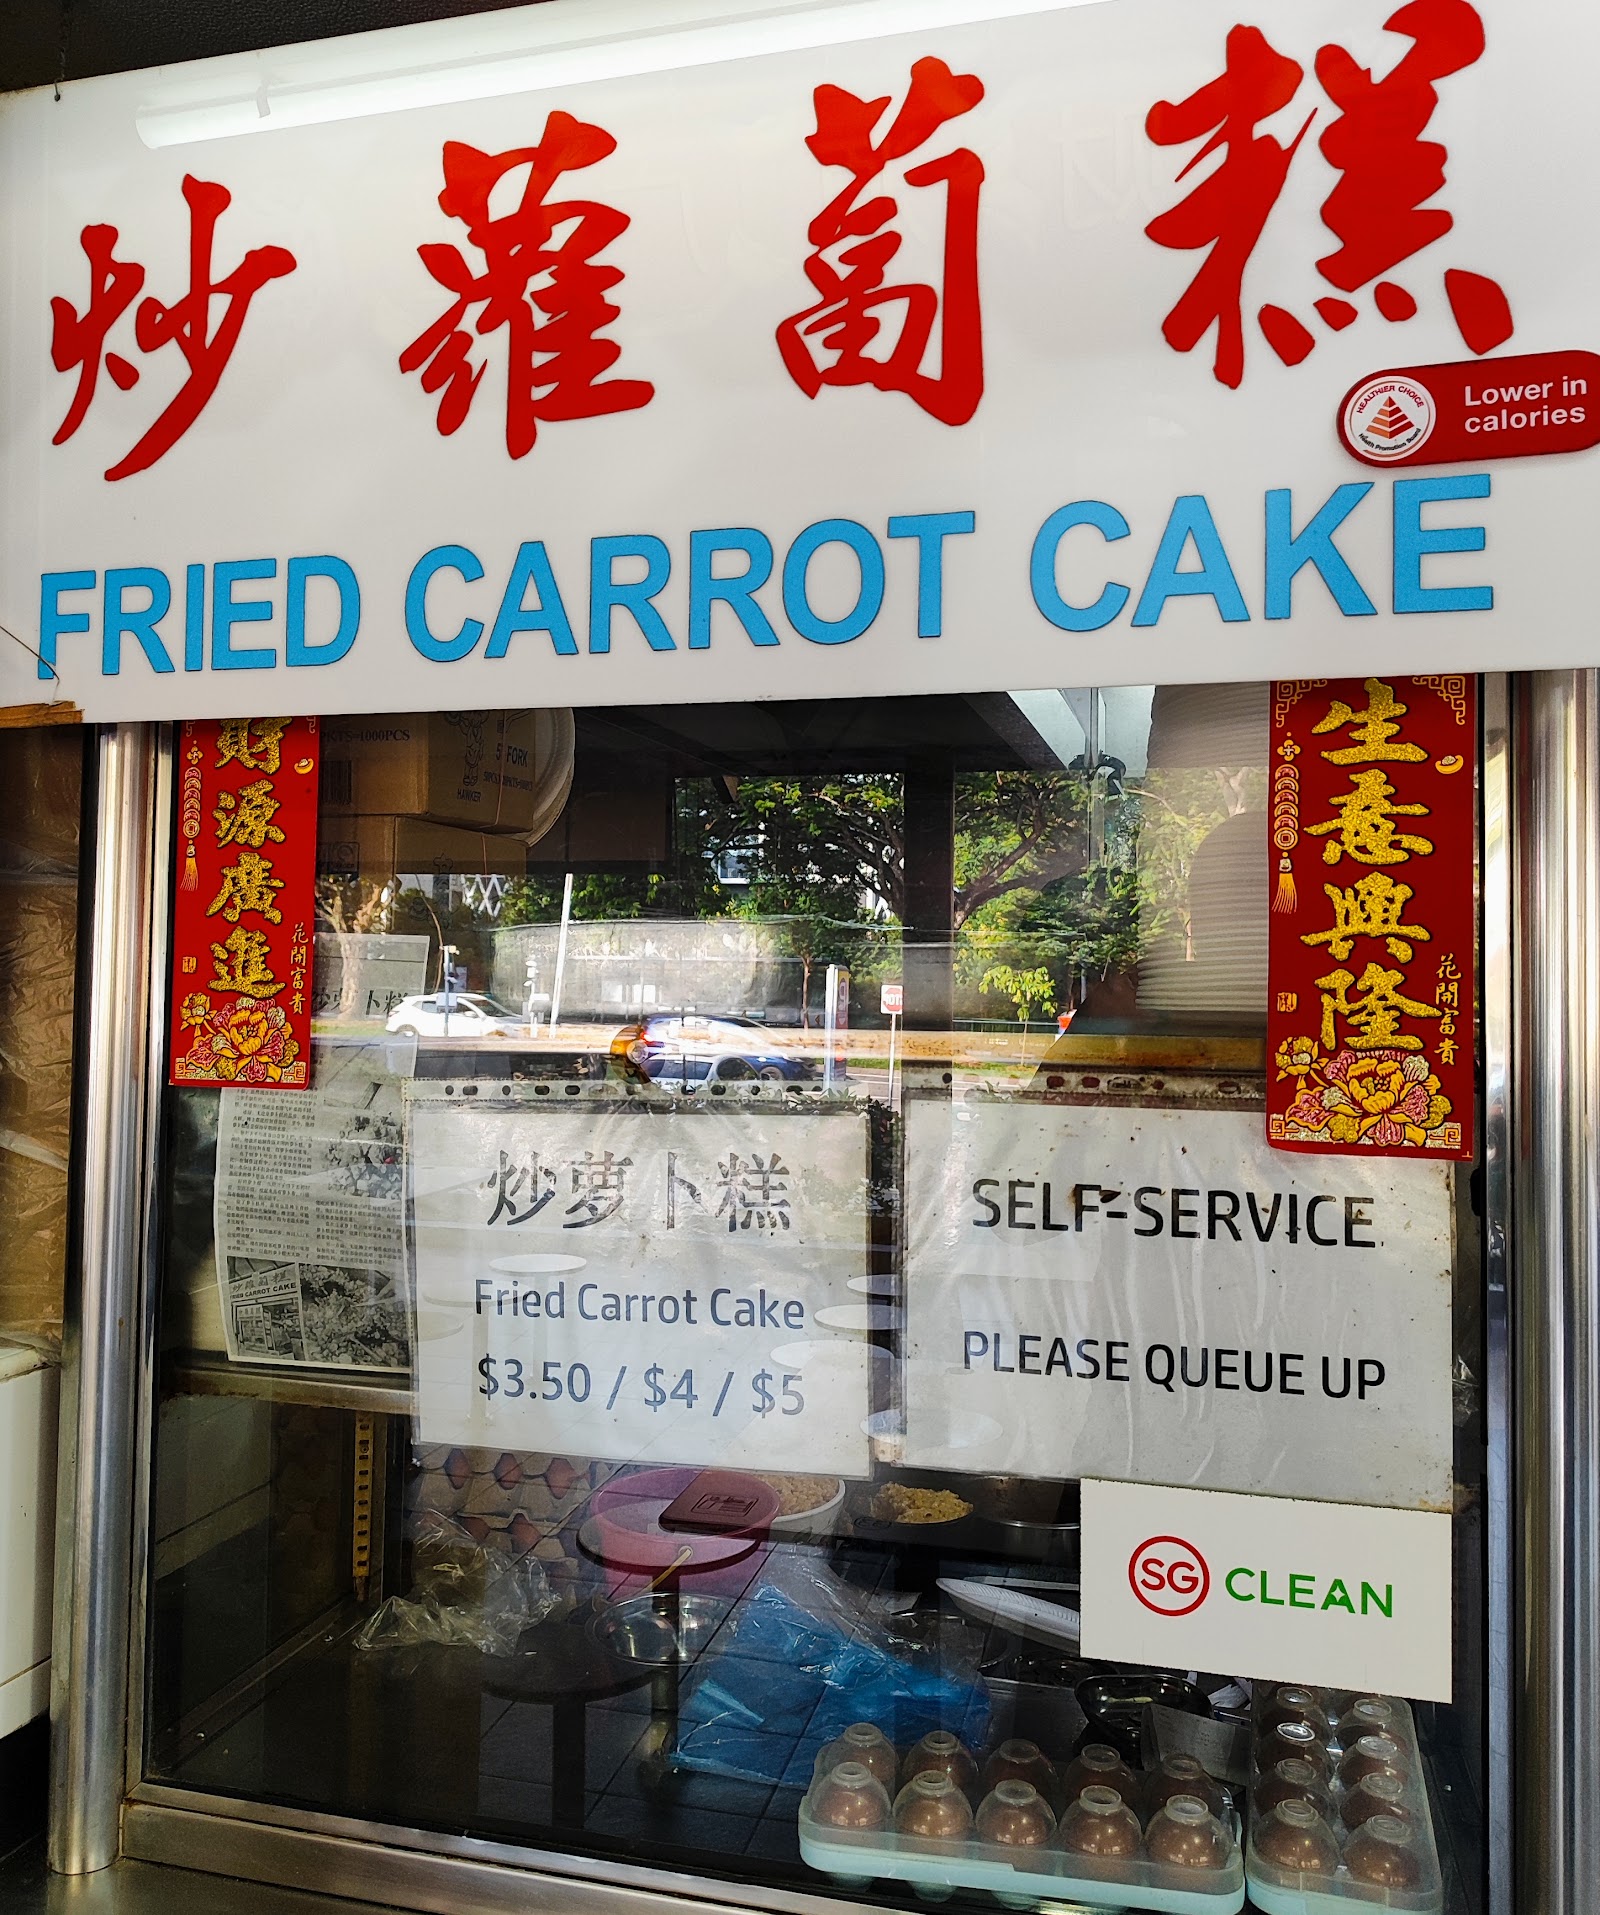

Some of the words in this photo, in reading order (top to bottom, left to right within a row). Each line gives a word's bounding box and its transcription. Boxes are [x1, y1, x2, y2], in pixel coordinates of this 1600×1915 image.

[51, 0, 1513, 481] 炒蘿蔔糕
[1356, 385, 1395, 414] HEALTHIER
[1398, 385, 1424, 408] CHOICE
[1465, 383, 1553, 407] Lower
[1563, 376, 1587, 396] in
[1465, 406, 1586, 433] calories
[37, 555, 361, 679] FRIED
[404, 511, 976, 662] CARROT
[1030, 473, 1494, 632] CAKE
[506, 745, 528, 768] FORK
[206, 717, 293, 998] 財源廣進
[1301, 678, 1442, 1049] 生意興隆
[288, 922, 310, 1016] 花開富貴
[1433, 953, 1462, 1066] 花開富貴
[486, 1149, 792, 1232] 炒萝卜糕
[972, 1178, 1376, 1249] SELF-SERVICE
[244, 1287, 271, 1298] CARROT
[272, 1282, 297, 1292] CAKE
[475, 1279, 565, 1319] Fried
[578, 1283, 698, 1325] Carrot
[710, 1288, 805, 1330] Cake
[478, 1352, 591, 1401] $3.50
[606, 1365, 627, 1410] /
[644, 1362, 699, 1413] $4
[712, 1371, 735, 1417] /
[752, 1368, 805, 1419] $5
[963, 1330, 1130, 1382] PLEASE
[1145, 1344, 1305, 1396] QUEUE
[1321, 1356, 1386, 1400] UP
[1139, 1557, 1201, 1592] SG
[1225, 1567, 1393, 1618] CLEAN
